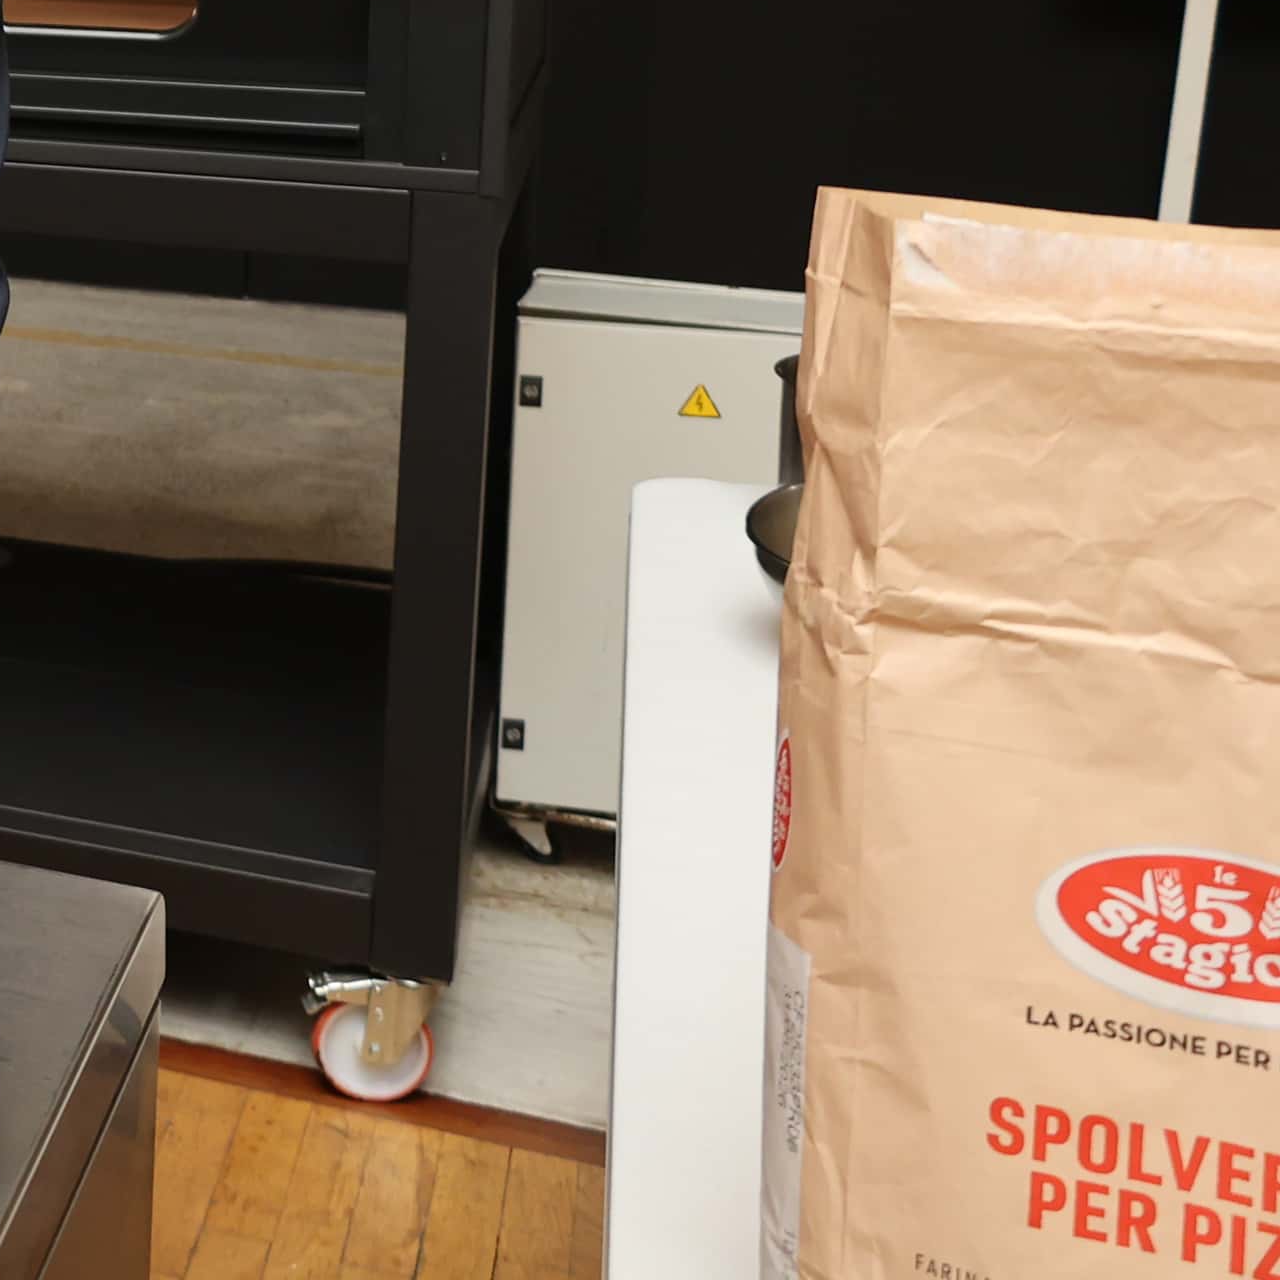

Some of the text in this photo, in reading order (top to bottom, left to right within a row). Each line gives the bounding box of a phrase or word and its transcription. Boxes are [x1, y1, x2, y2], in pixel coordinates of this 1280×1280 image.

[1213, 865, 1239, 885] le
[1189, 883, 1254, 938] 5
[1026, 1006, 1271, 1071] LA PASSIONE PER
[1027, 1170, 1158, 1254] PER
